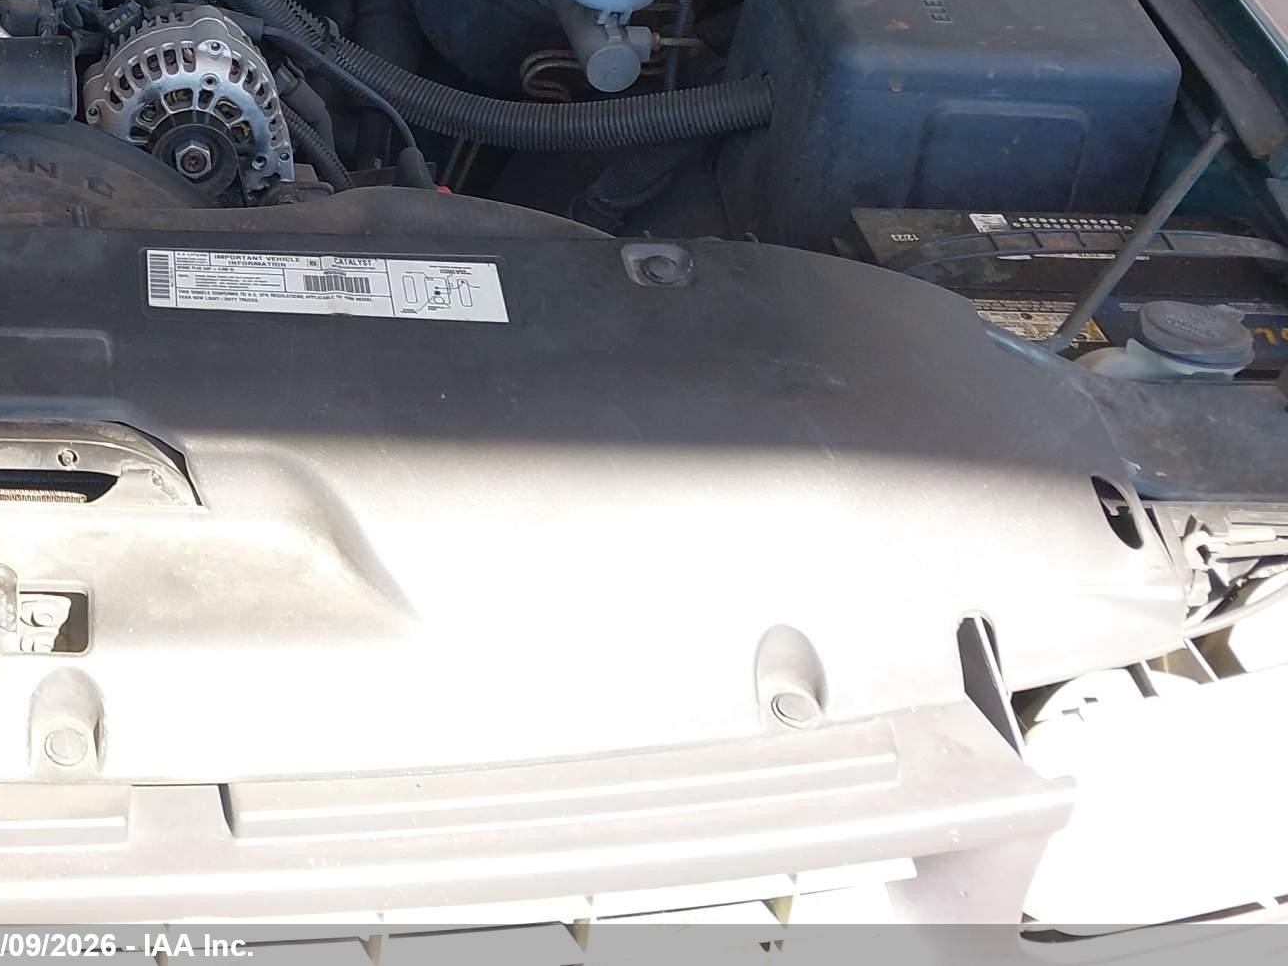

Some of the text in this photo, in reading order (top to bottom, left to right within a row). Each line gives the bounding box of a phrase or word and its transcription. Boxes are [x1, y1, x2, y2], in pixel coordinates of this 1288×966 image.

[214, 254, 263, 262] IMPORTANT
[333, 257, 372, 266] CATALYST
[228, 260, 287, 268] INFORMATION
